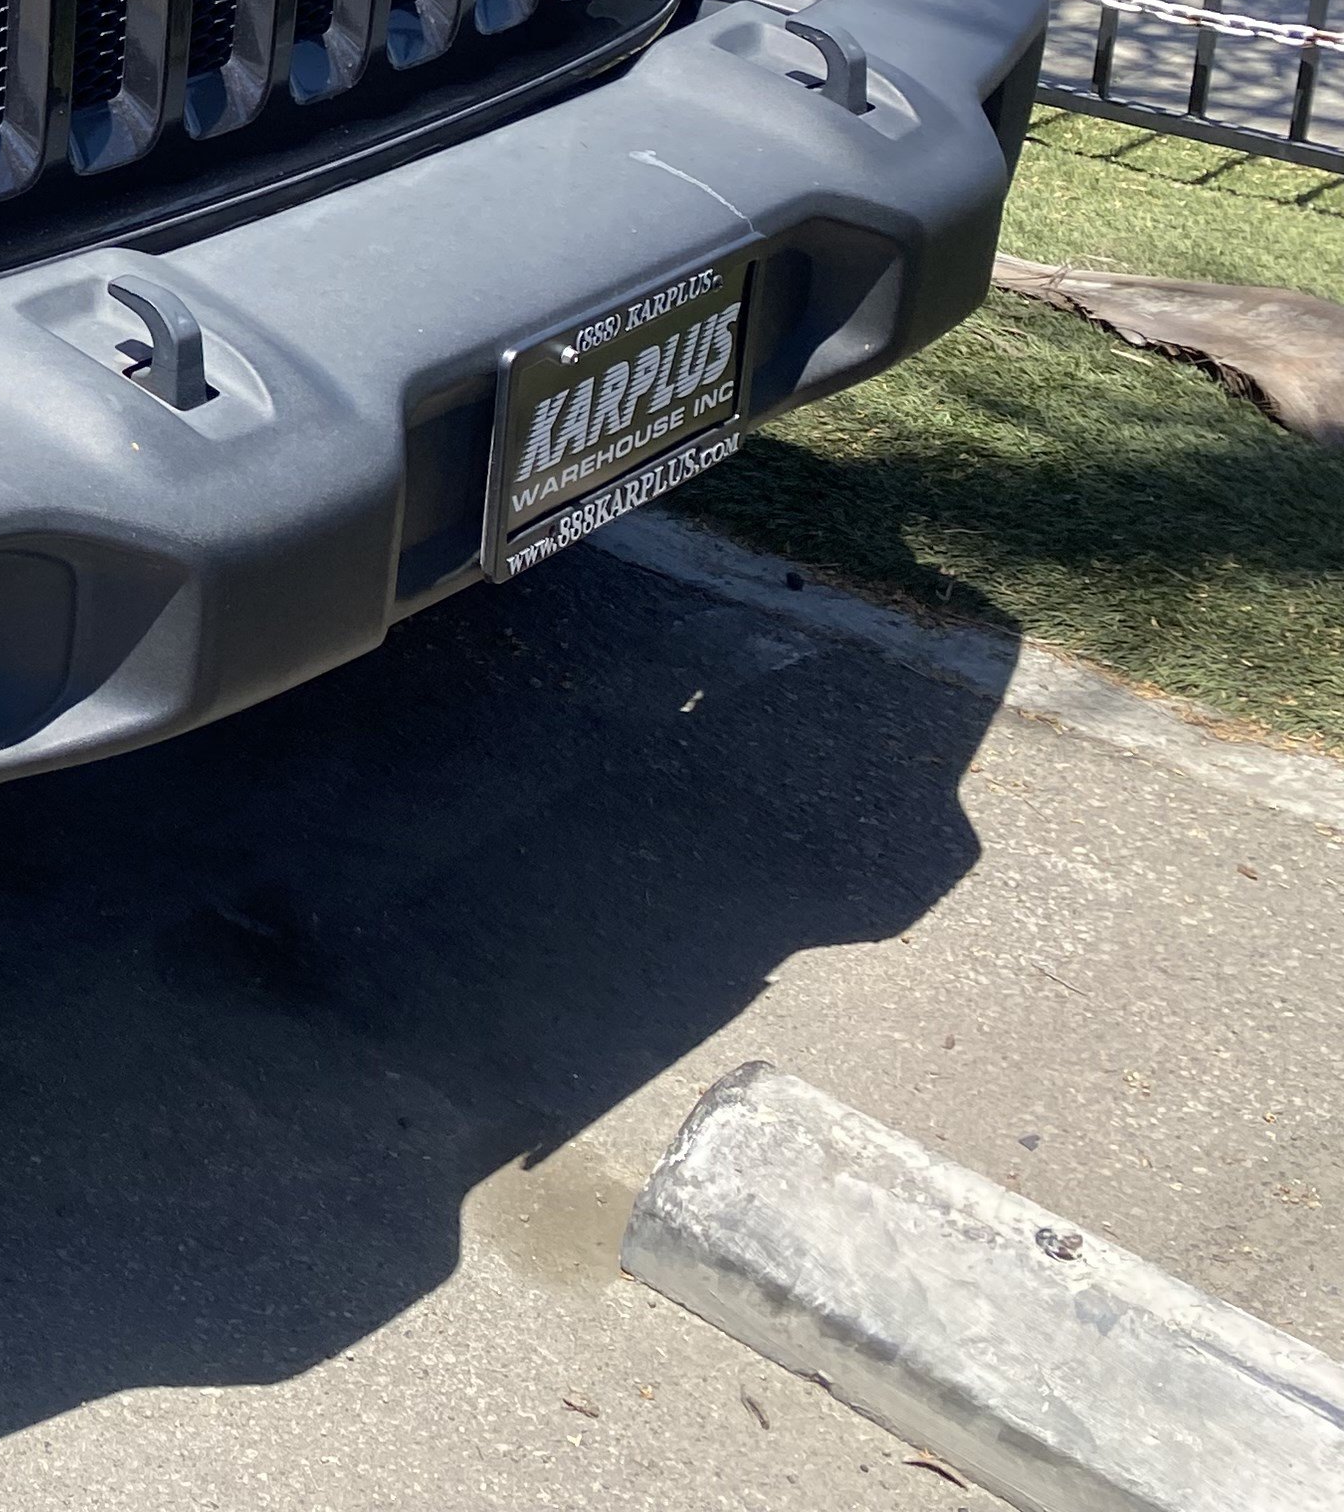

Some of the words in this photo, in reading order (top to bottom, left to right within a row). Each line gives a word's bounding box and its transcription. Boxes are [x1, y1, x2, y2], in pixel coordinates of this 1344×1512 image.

[575, 313, 622, 355] (888)
[624, 268, 714, 332] KARPLUS
[511, 406, 685, 513] WAREHOUSE
[693, 380, 734, 418] INC
[513, 301, 742, 484] KARPLUS
